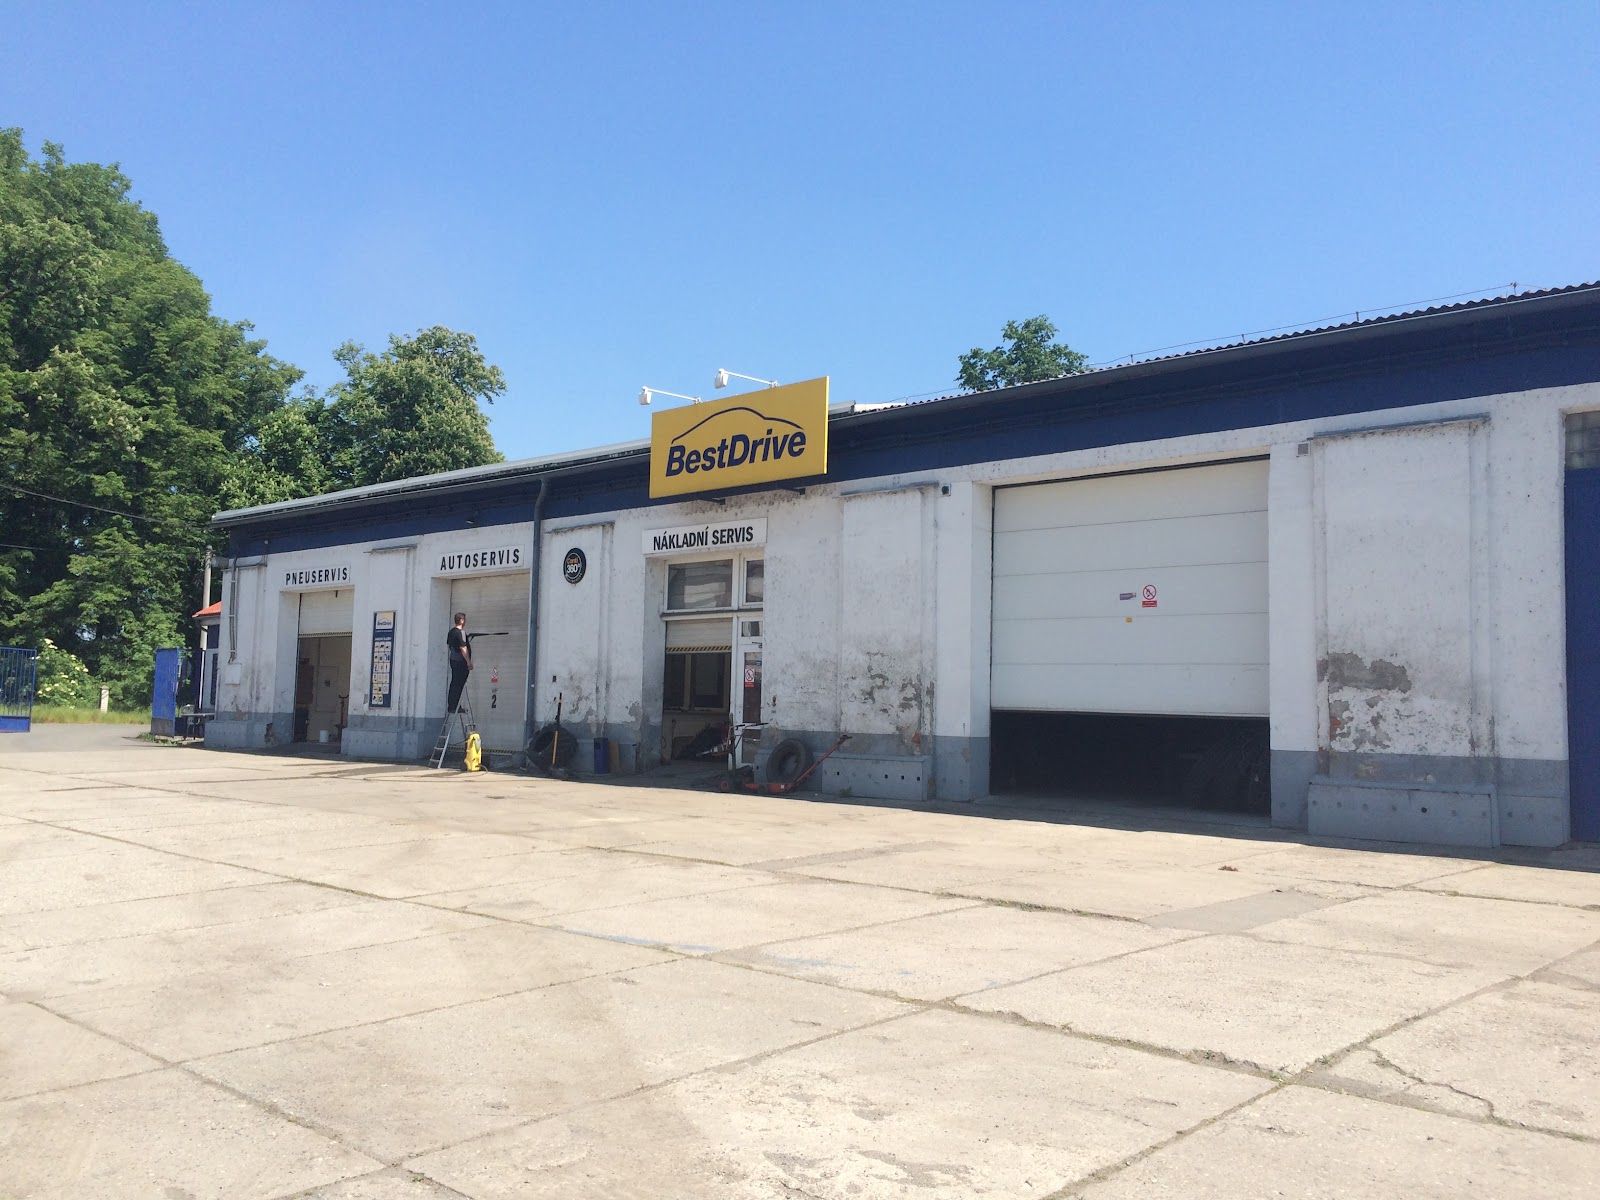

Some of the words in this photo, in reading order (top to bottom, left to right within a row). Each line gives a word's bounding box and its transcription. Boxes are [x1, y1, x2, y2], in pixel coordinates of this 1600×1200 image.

[665, 428, 807, 477] BestDrive
[653, 525, 709, 551] NÁKLADNÍ
[711, 526, 754, 545] SERVIS
[440, 548, 520, 571] AUTOSERVIS
[285, 567, 348, 586] PNEUSERVIS
[491, 694, 497, 709] 2
